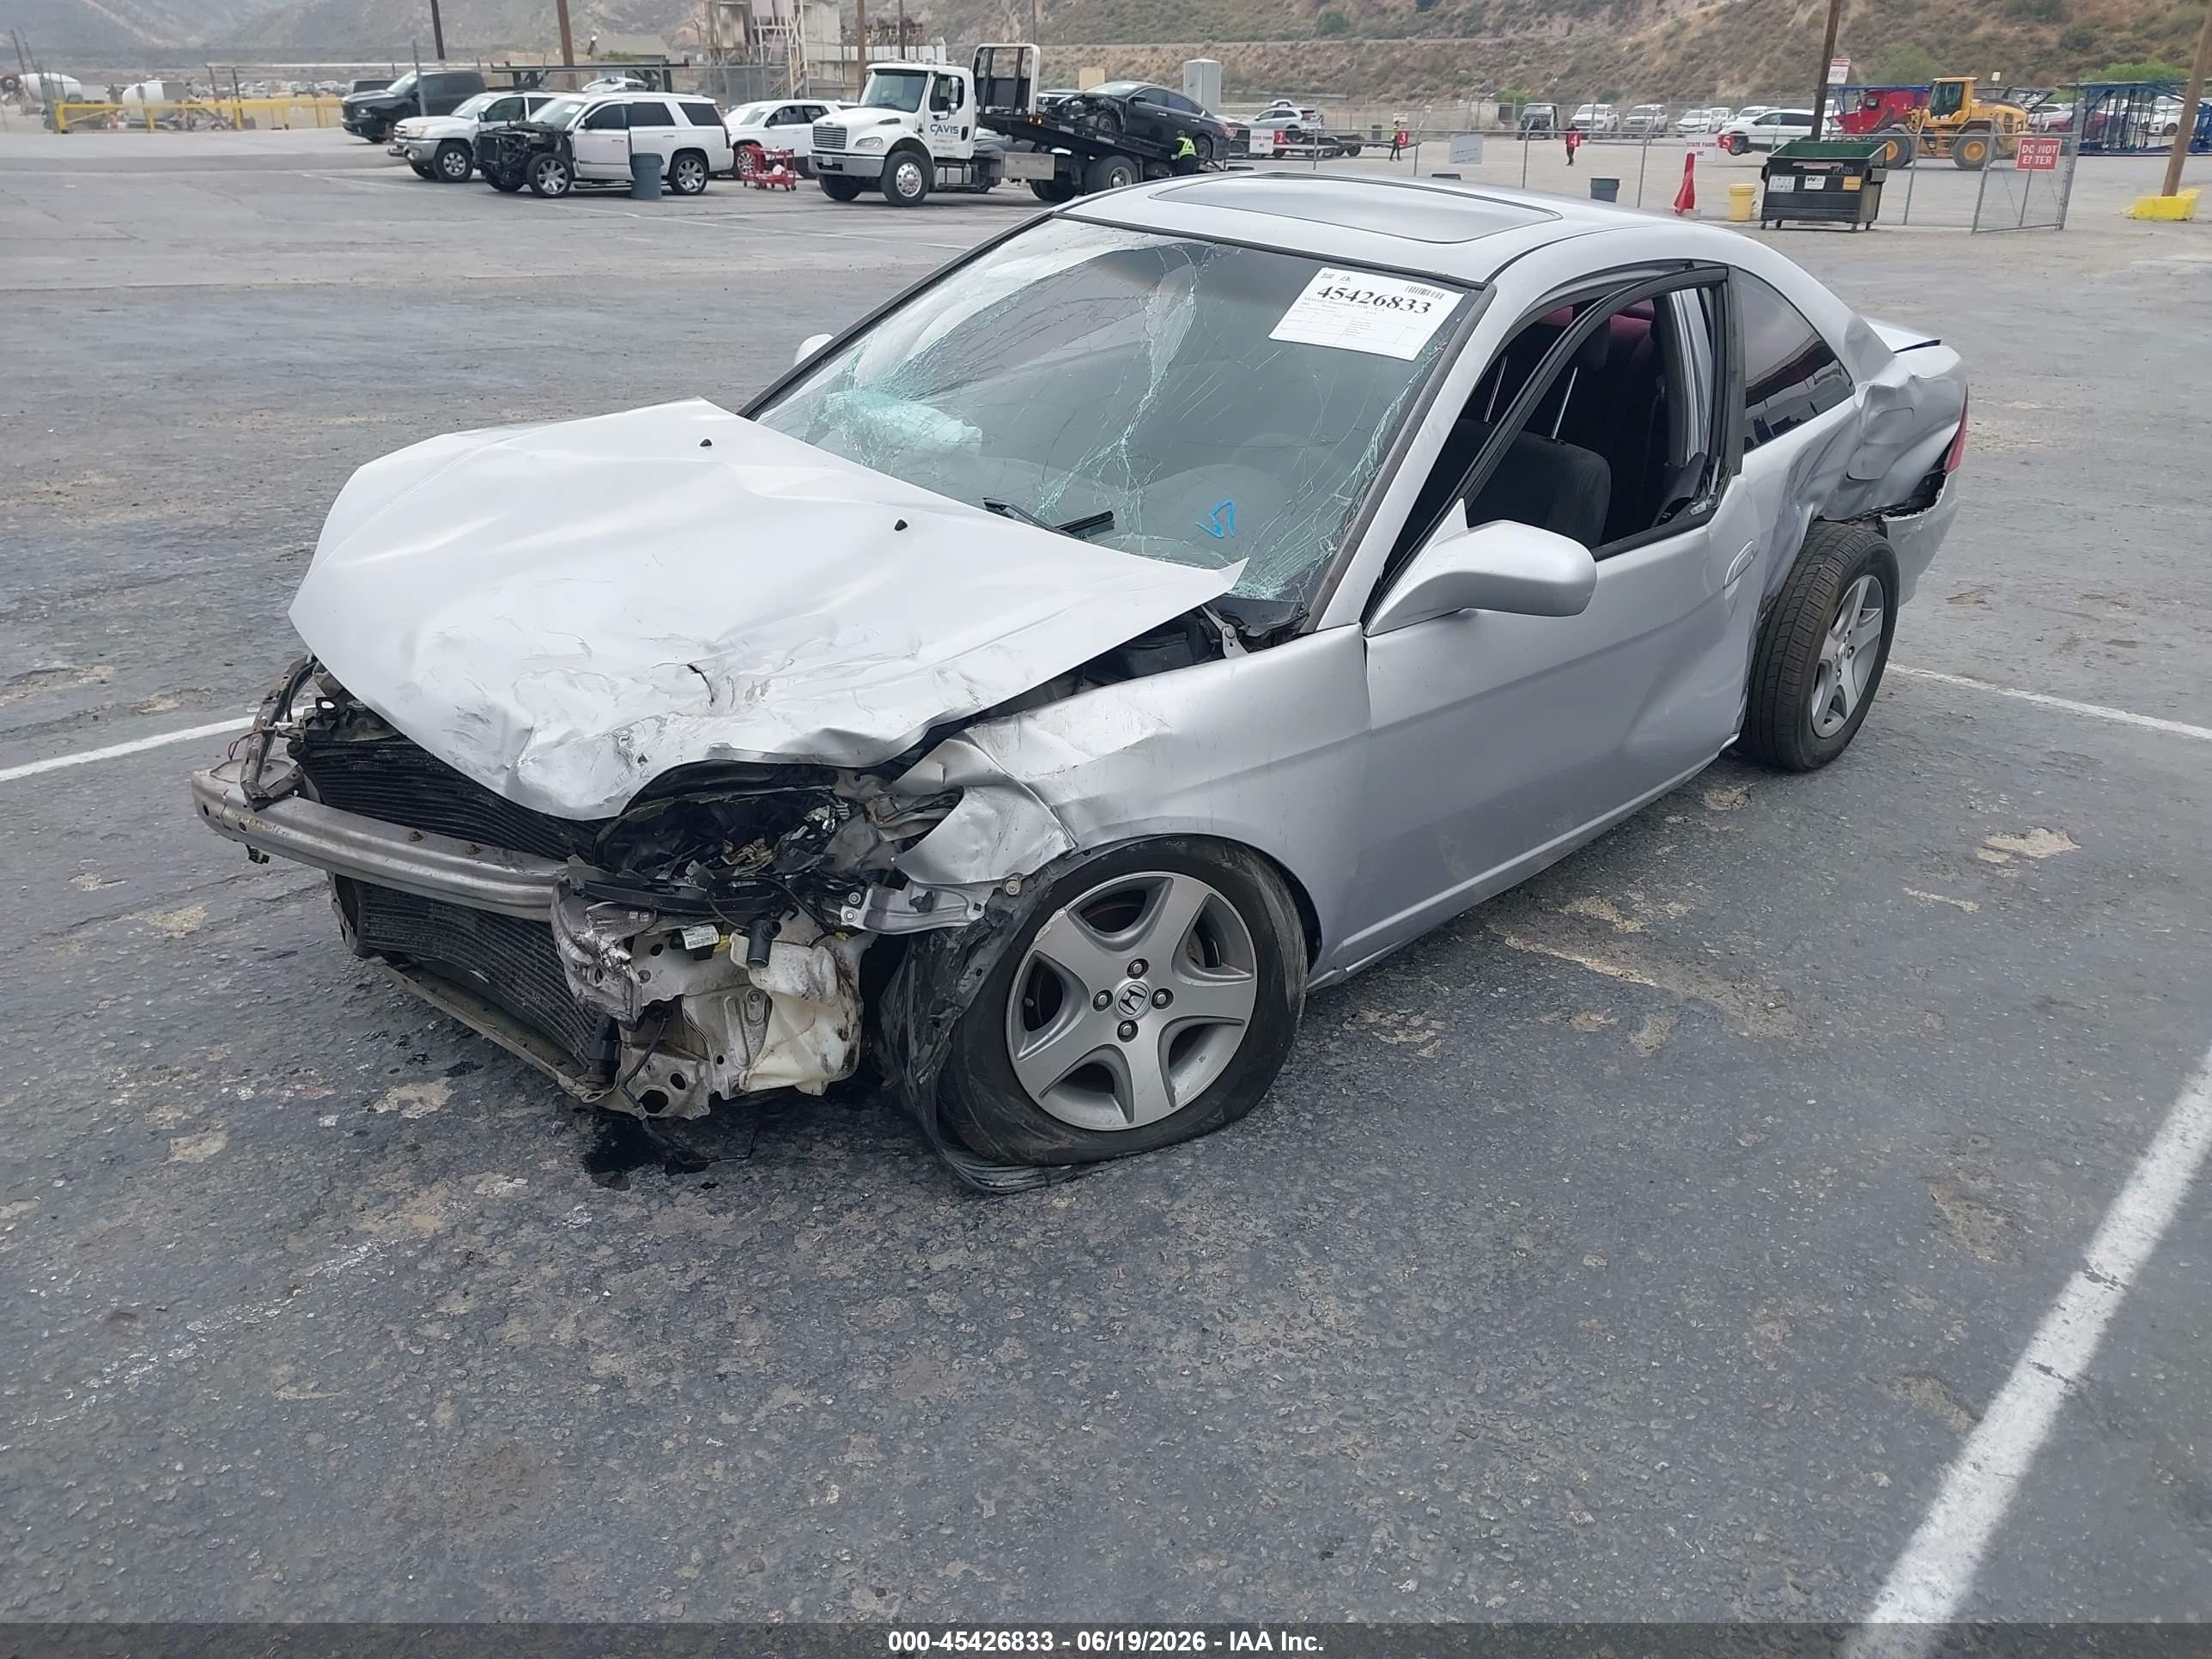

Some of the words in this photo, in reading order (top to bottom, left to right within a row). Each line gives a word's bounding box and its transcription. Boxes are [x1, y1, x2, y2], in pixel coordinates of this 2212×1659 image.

[930, 124, 959, 136] CAVIS
[1277, 131, 1284, 143] 2
[1399, 131, 1407, 143] 3
[1570, 134, 1577, 146] 4
[1723, 136, 1731, 148] 5
[2021, 144, 2034, 154] DO
[2038, 144, 2057, 154] NOT
[1317, 286, 1431, 314] 45426833
